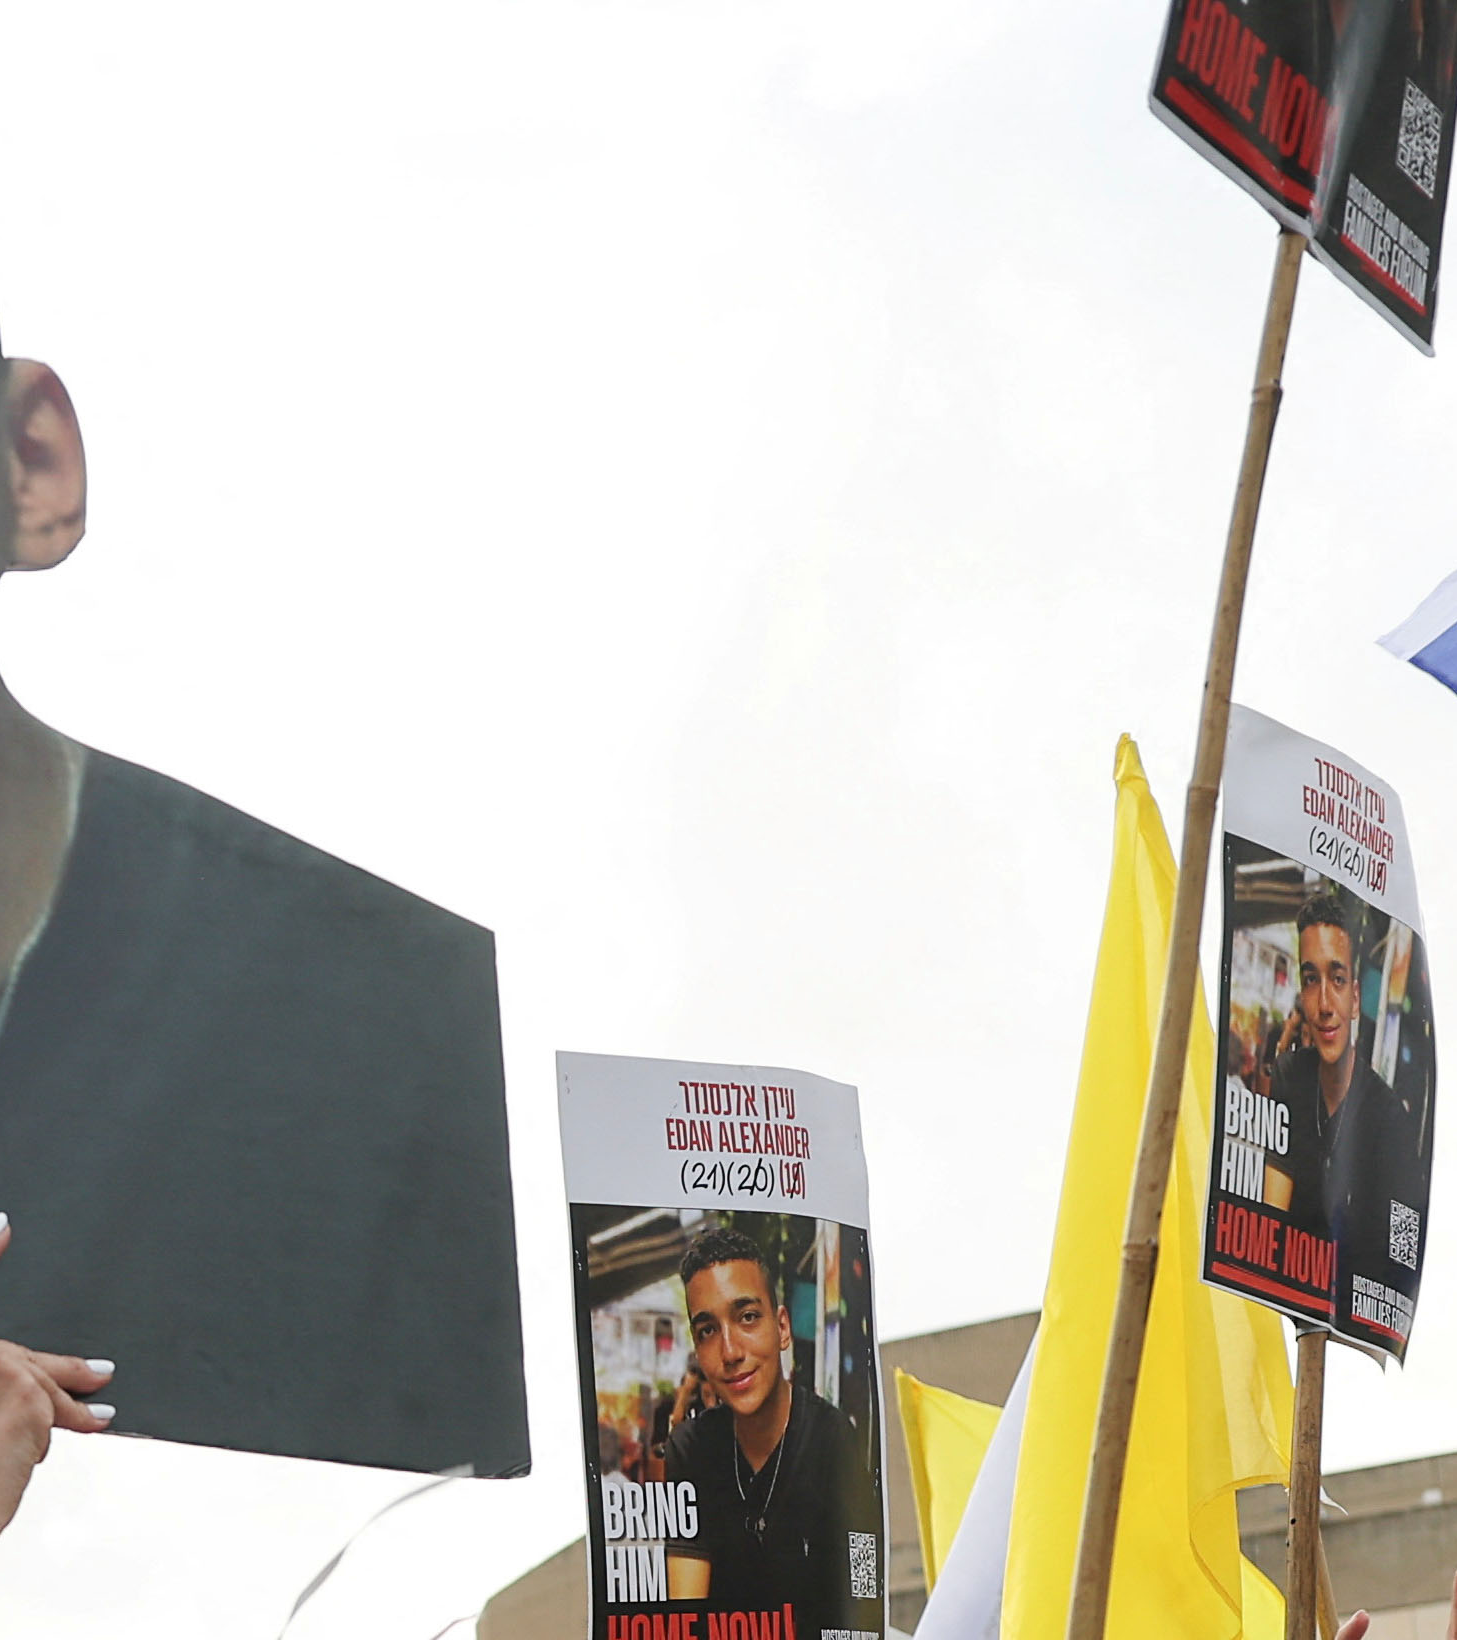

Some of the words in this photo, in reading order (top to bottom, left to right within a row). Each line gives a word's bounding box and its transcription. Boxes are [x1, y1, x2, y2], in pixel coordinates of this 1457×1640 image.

[1177, 0, 1268, 123] HOME
[1303, 785, 1336, 827] EDAN
[1337, 803, 1394, 864] ALEXANDER
[679, 1081, 759, 1117] אלכסנדר
[761, 1085, 796, 1121] עידן
[1225, 1080, 1290, 1155] BRING
[665, 1118, 713, 1152] EDAN
[719, 1120, 811, 1160] ALEXANDER
[1219, 1139, 1265, 1203] HIM
[1215, 1200, 1280, 1272] HOME
[1351, 1292, 1391, 1328] FAMILIES
[602, 1480, 699, 1541] BRING
[605, 1545, 667, 1603] HIM
